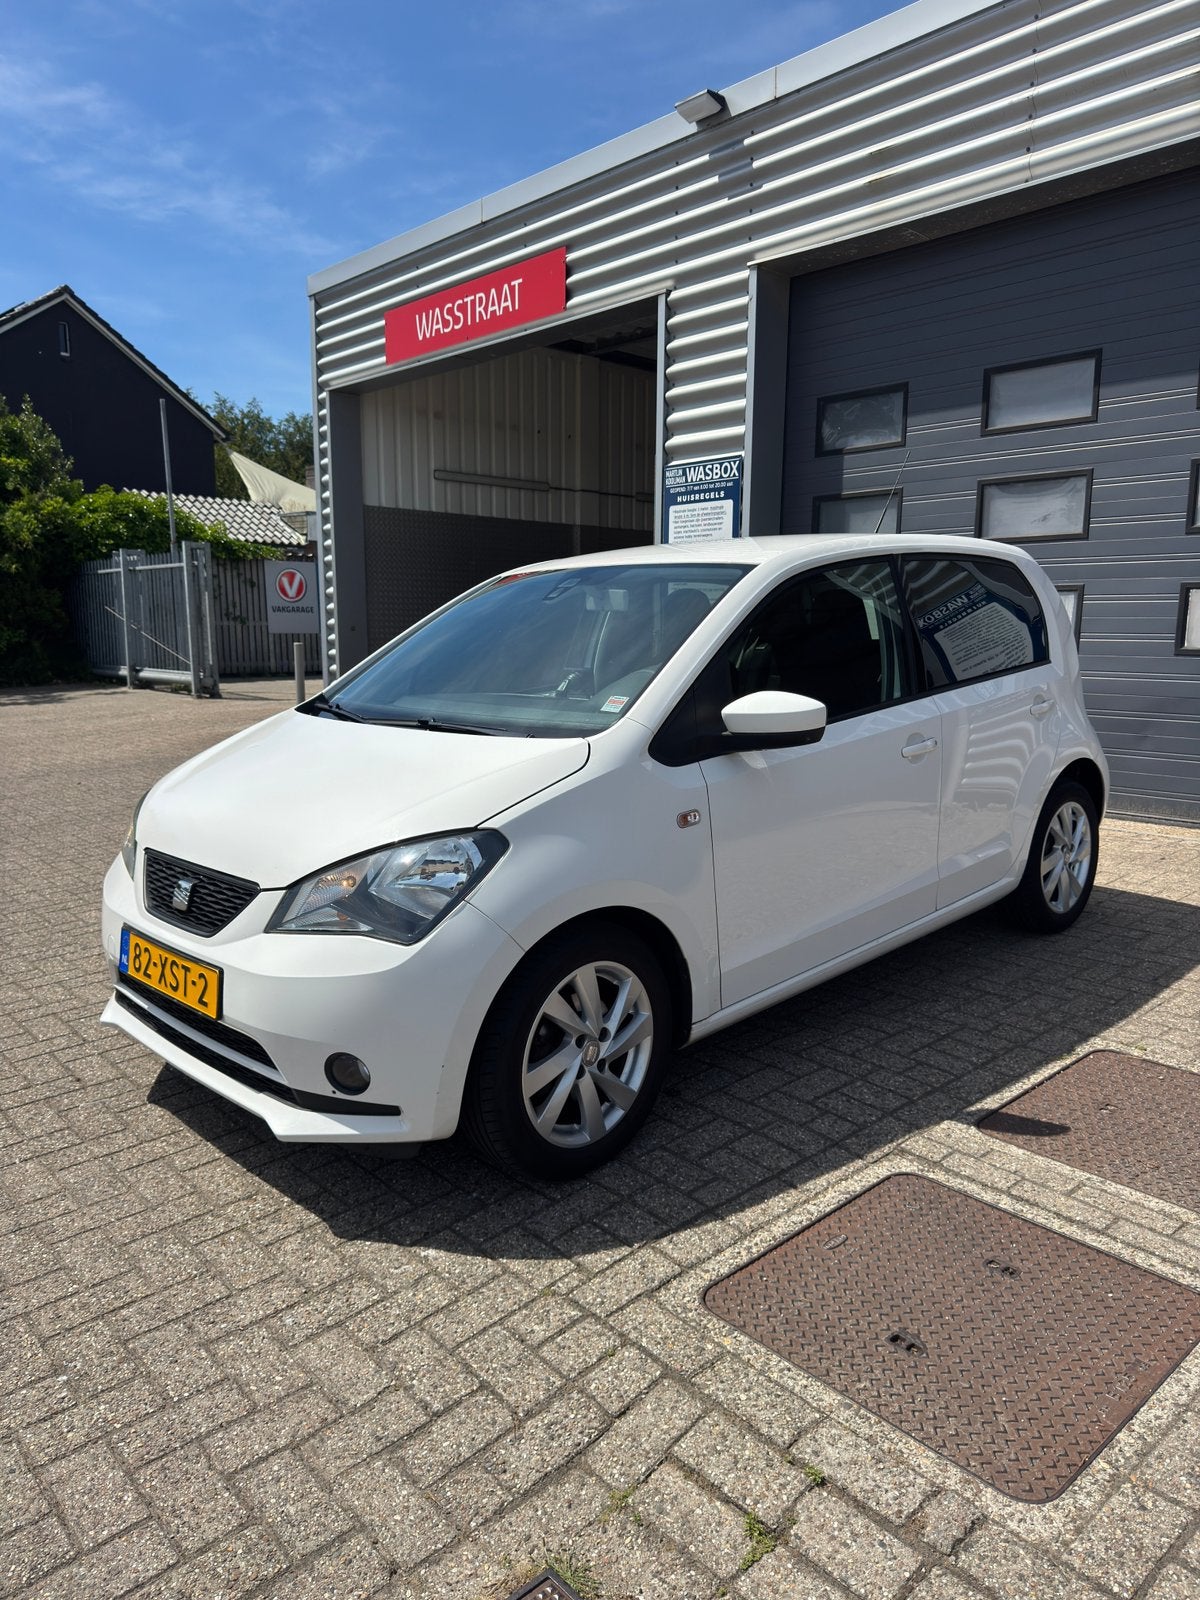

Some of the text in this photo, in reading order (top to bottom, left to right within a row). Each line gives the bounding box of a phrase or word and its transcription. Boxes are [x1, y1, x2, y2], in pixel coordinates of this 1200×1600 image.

[415, 278, 523, 341] WASSTRAAT
[686, 461, 740, 483] WASBOX
[677, 490, 725, 503] HUISREGELS
[271, 605, 315, 615] VAKGARAGE
[133, 942, 209, 1009] 82-XST-2
